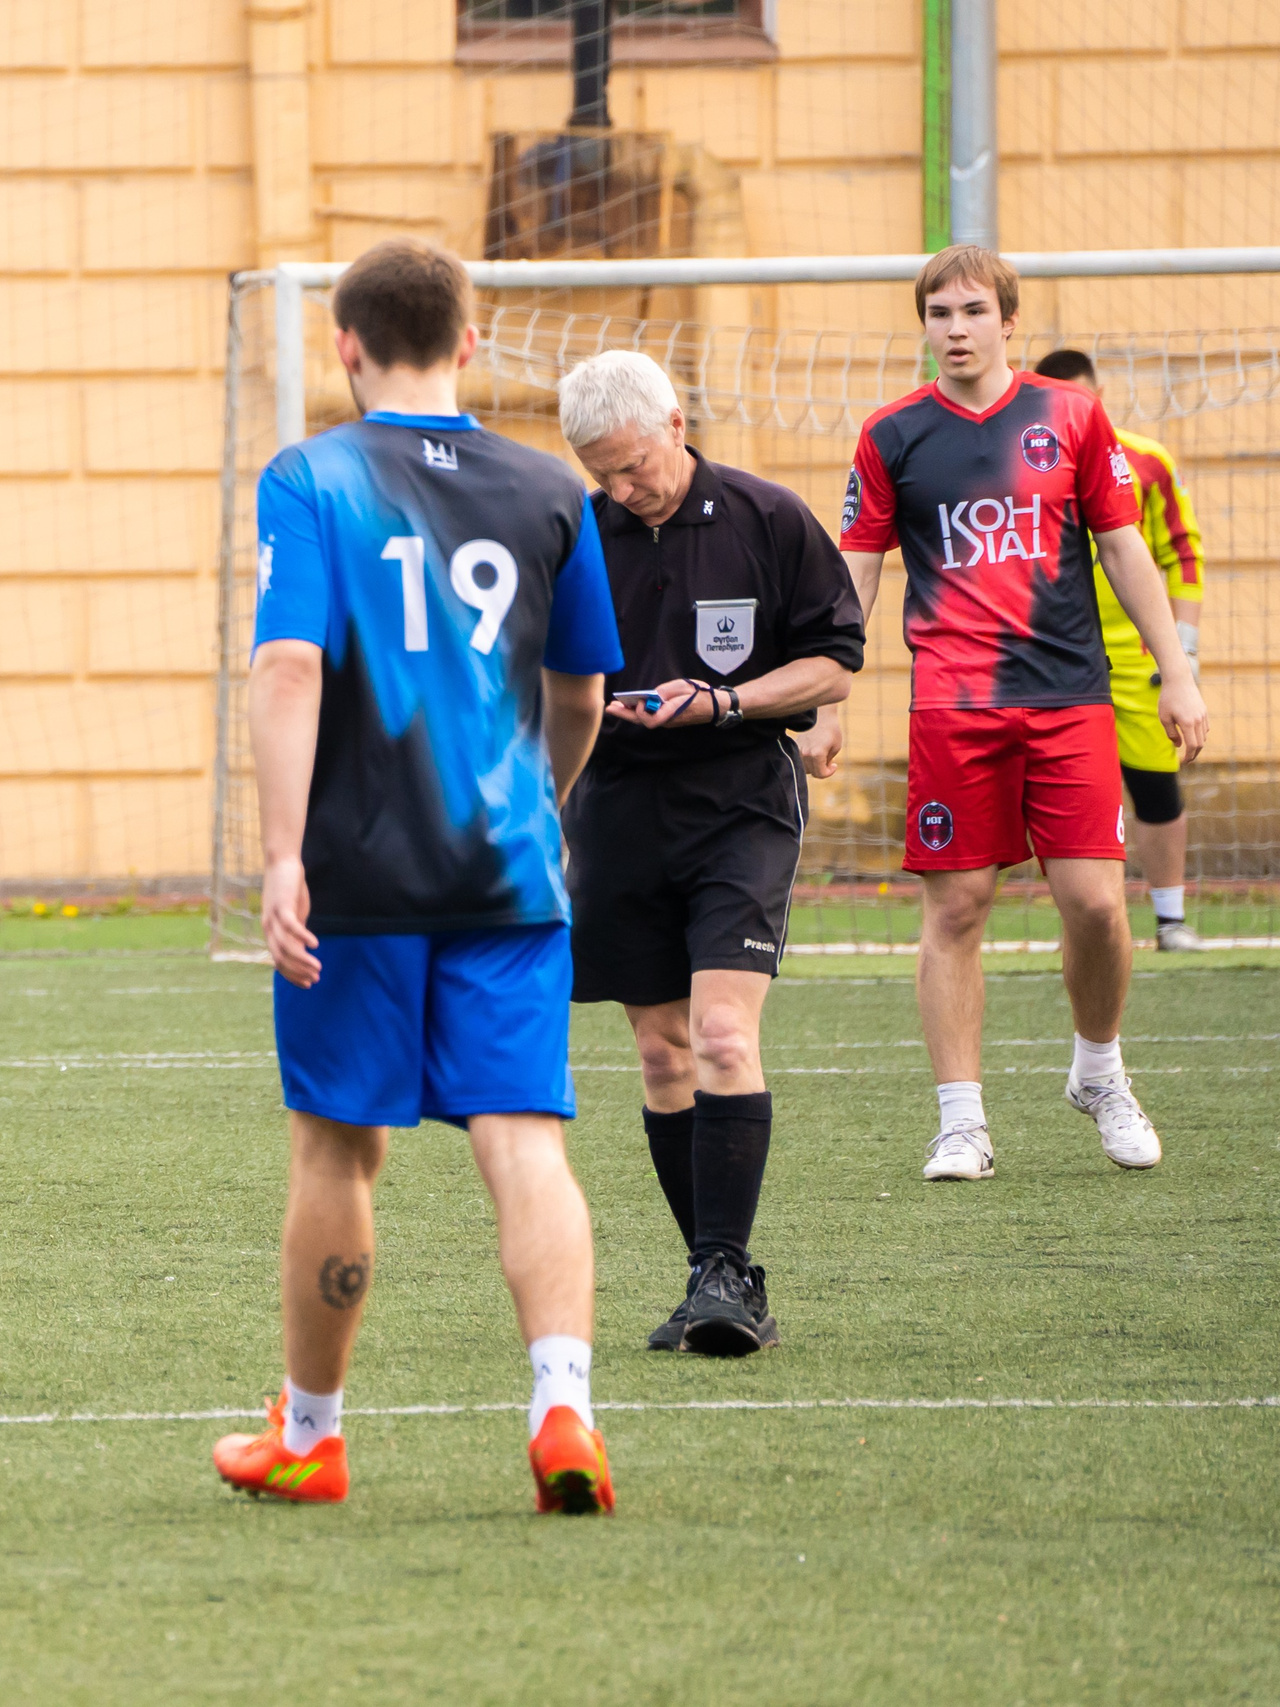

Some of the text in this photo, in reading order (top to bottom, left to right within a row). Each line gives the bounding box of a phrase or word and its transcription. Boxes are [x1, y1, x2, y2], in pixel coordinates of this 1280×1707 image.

[379, 535, 520, 656] 19
[713, 635, 739, 645] Футбол
[706, 643, 745, 653] Петербурга
